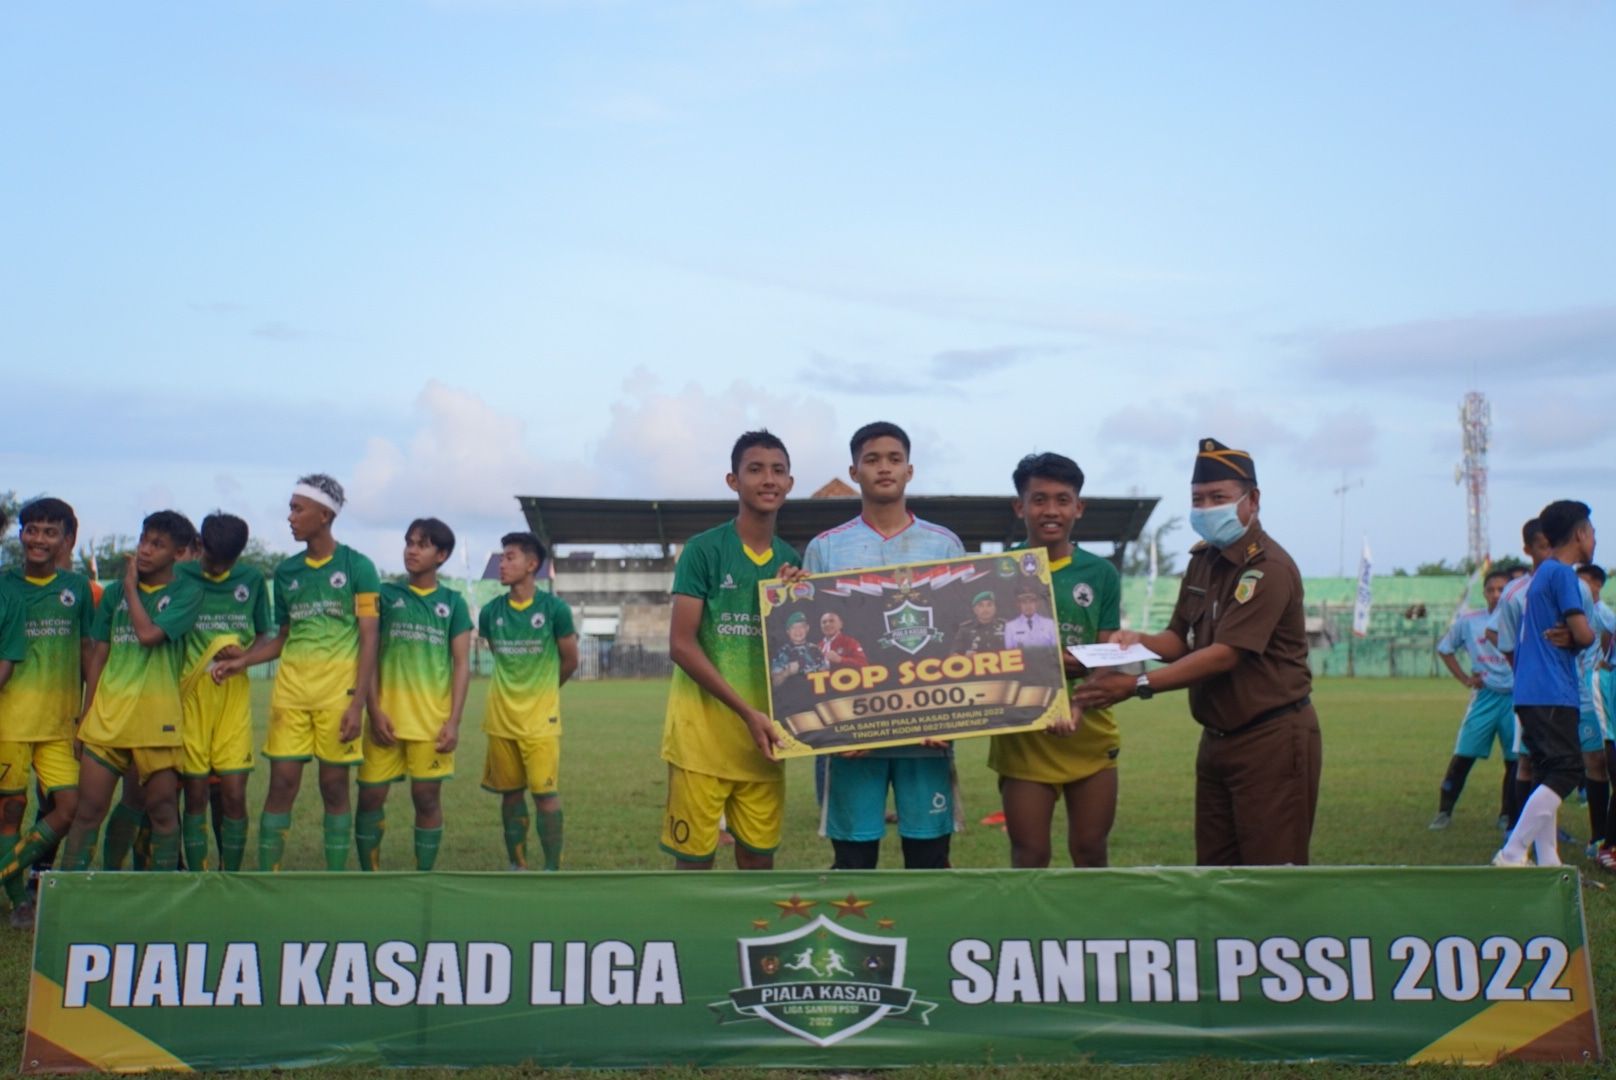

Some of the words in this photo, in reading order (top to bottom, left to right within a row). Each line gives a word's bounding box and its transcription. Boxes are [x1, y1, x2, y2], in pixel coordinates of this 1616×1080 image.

[807, 665, 888, 694] TOP
[899, 649, 1025, 685] SCORE
[852, 686, 986, 716] 500.000,-
[834, 725, 857, 733] LIGA
[857, 721, 890, 731] SANTRI
[891, 718, 917, 727] PIALA
[918, 714, 950, 724] KASAD
[951, 711, 982, 721] TAHUN
[983, 708, 1004, 717] 2022
[852, 729, 891, 740] TINGKAT
[891, 725, 922, 736] KODIM
[669, 815, 690, 845] 10
[61, 941, 263, 1008] PIALA
[279, 940, 512, 1006] KASAD
[529, 939, 685, 1006] LIGA
[948, 937, 1200, 1004] SANTRI
[1215, 936, 1374, 1003] PSSI
[1388, 936, 1574, 1002] 2022
[761, 986, 815, 1003] PIALA
[819, 985, 881, 1003] KASAD
[783, 1005, 804, 1015] LIGA
[805, 1005, 838, 1015] SANTRI
[839, 1005, 860, 1015] PSSI
[809, 1017, 834, 1027] 2022
